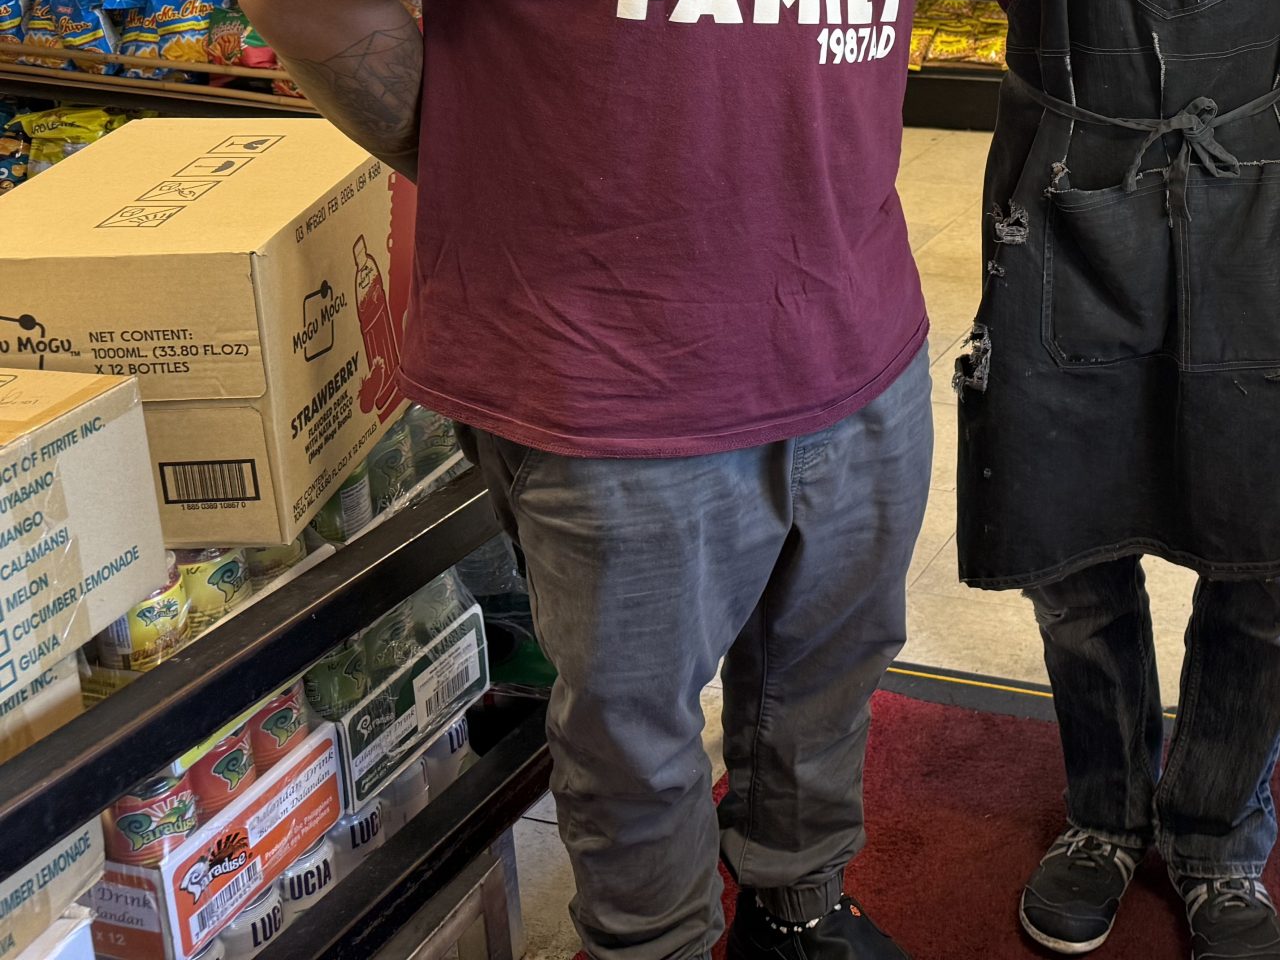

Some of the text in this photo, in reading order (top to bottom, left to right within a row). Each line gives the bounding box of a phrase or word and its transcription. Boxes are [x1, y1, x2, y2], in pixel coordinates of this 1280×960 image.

[18, 336, 72, 354] MOGU
[88, 329, 193, 343] NET CONTENT:
[91, 343, 249, 360] 1000ML. (33.80 FL.OZ)
[94, 362, 190, 375] X 12 BOTTLES
[291, 351, 359, 440] STRAWBERRY
[308, 390, 348, 439] FLAVORED DRINK
[21, 416, 106, 472] OF FITRITE INC.
[305, 432, 319, 454] WITH
[319, 418, 333, 440] NATA
[339, 396, 353, 420] COCO
[358, 423, 378, 451] BOTTLES
[0, 471, 53, 514] UYABANO
[293, 496, 303, 514] NET
[0, 526, 69, 580] CALAMANSI
[6, 573, 49, 612] MELON
[12, 545, 140, 641] CUCUMBER LEMONADE
[19, 633, 61, 671] GUAVA
[31, 668, 58, 692] INC.
[303, 749, 335, 783] Drink
[117, 813, 197, 852] Paradise
[0, 830, 91, 919] UMBER LEMONADE
[180, 850, 248, 905] Paradise
[99, 887, 152, 910] Drink
[110, 932, 127, 946] 12
